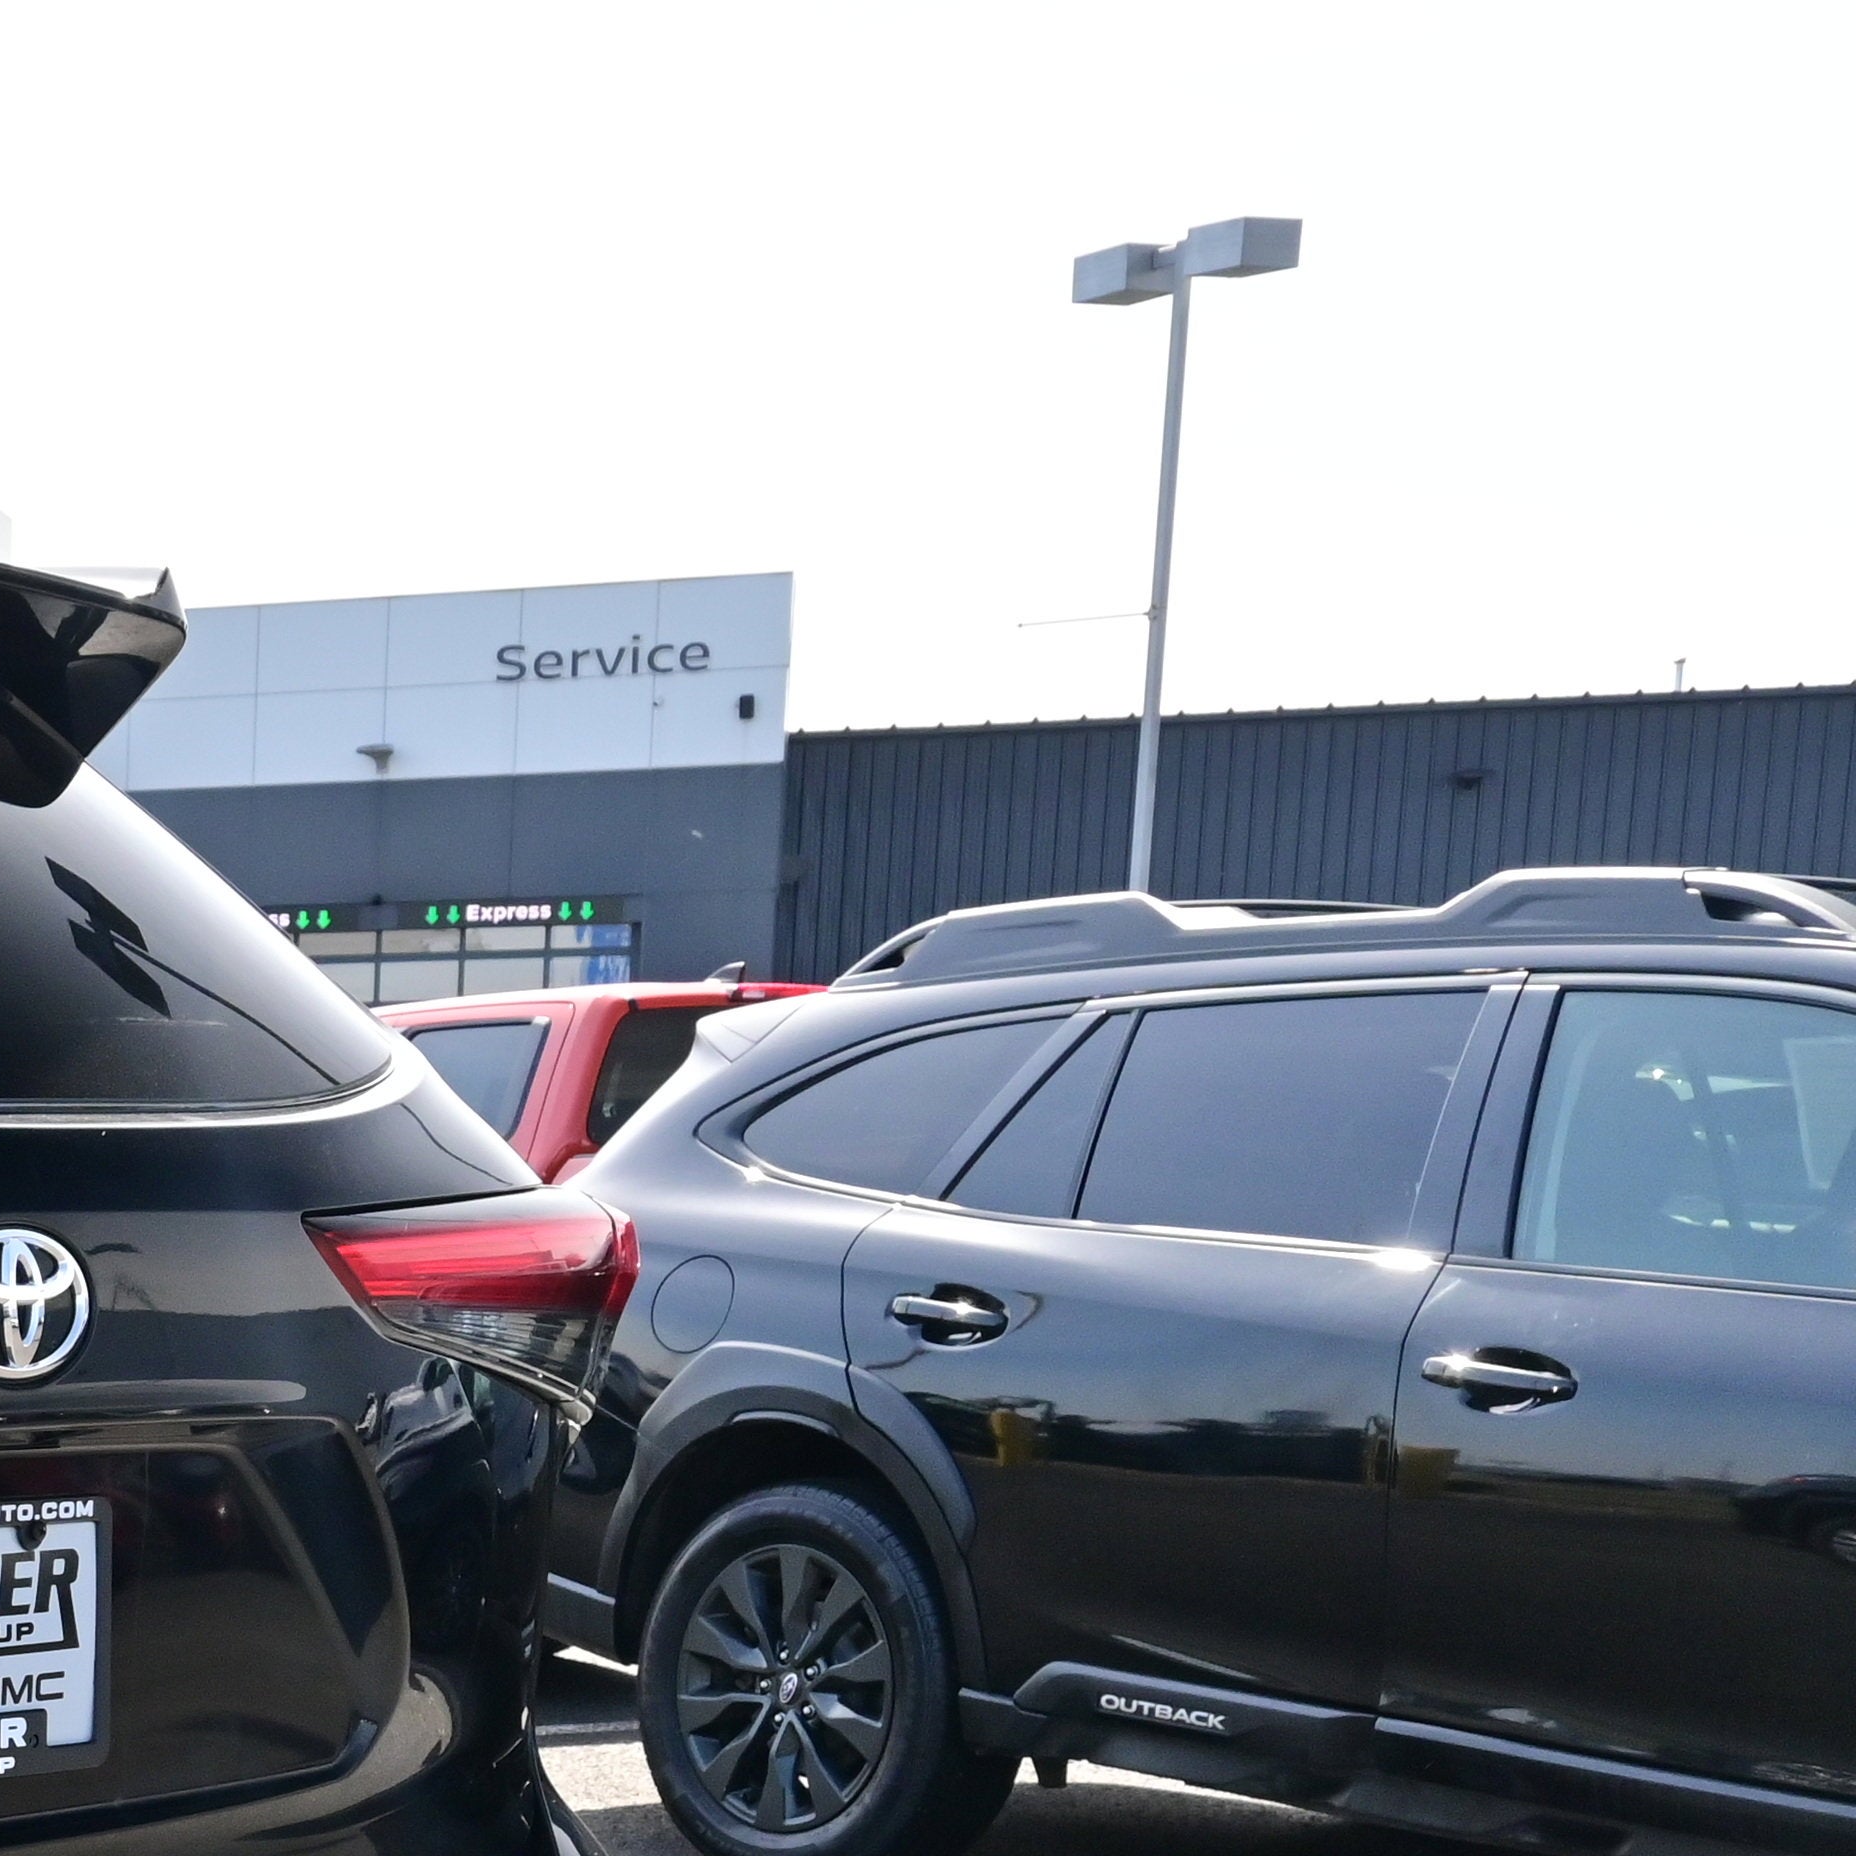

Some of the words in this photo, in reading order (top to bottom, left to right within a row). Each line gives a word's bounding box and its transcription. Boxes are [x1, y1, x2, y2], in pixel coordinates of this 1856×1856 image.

[495, 633, 711, 682] Service
[465, 903, 552, 925] Express
[1099, 1693, 1227, 1731] OUTBACK
